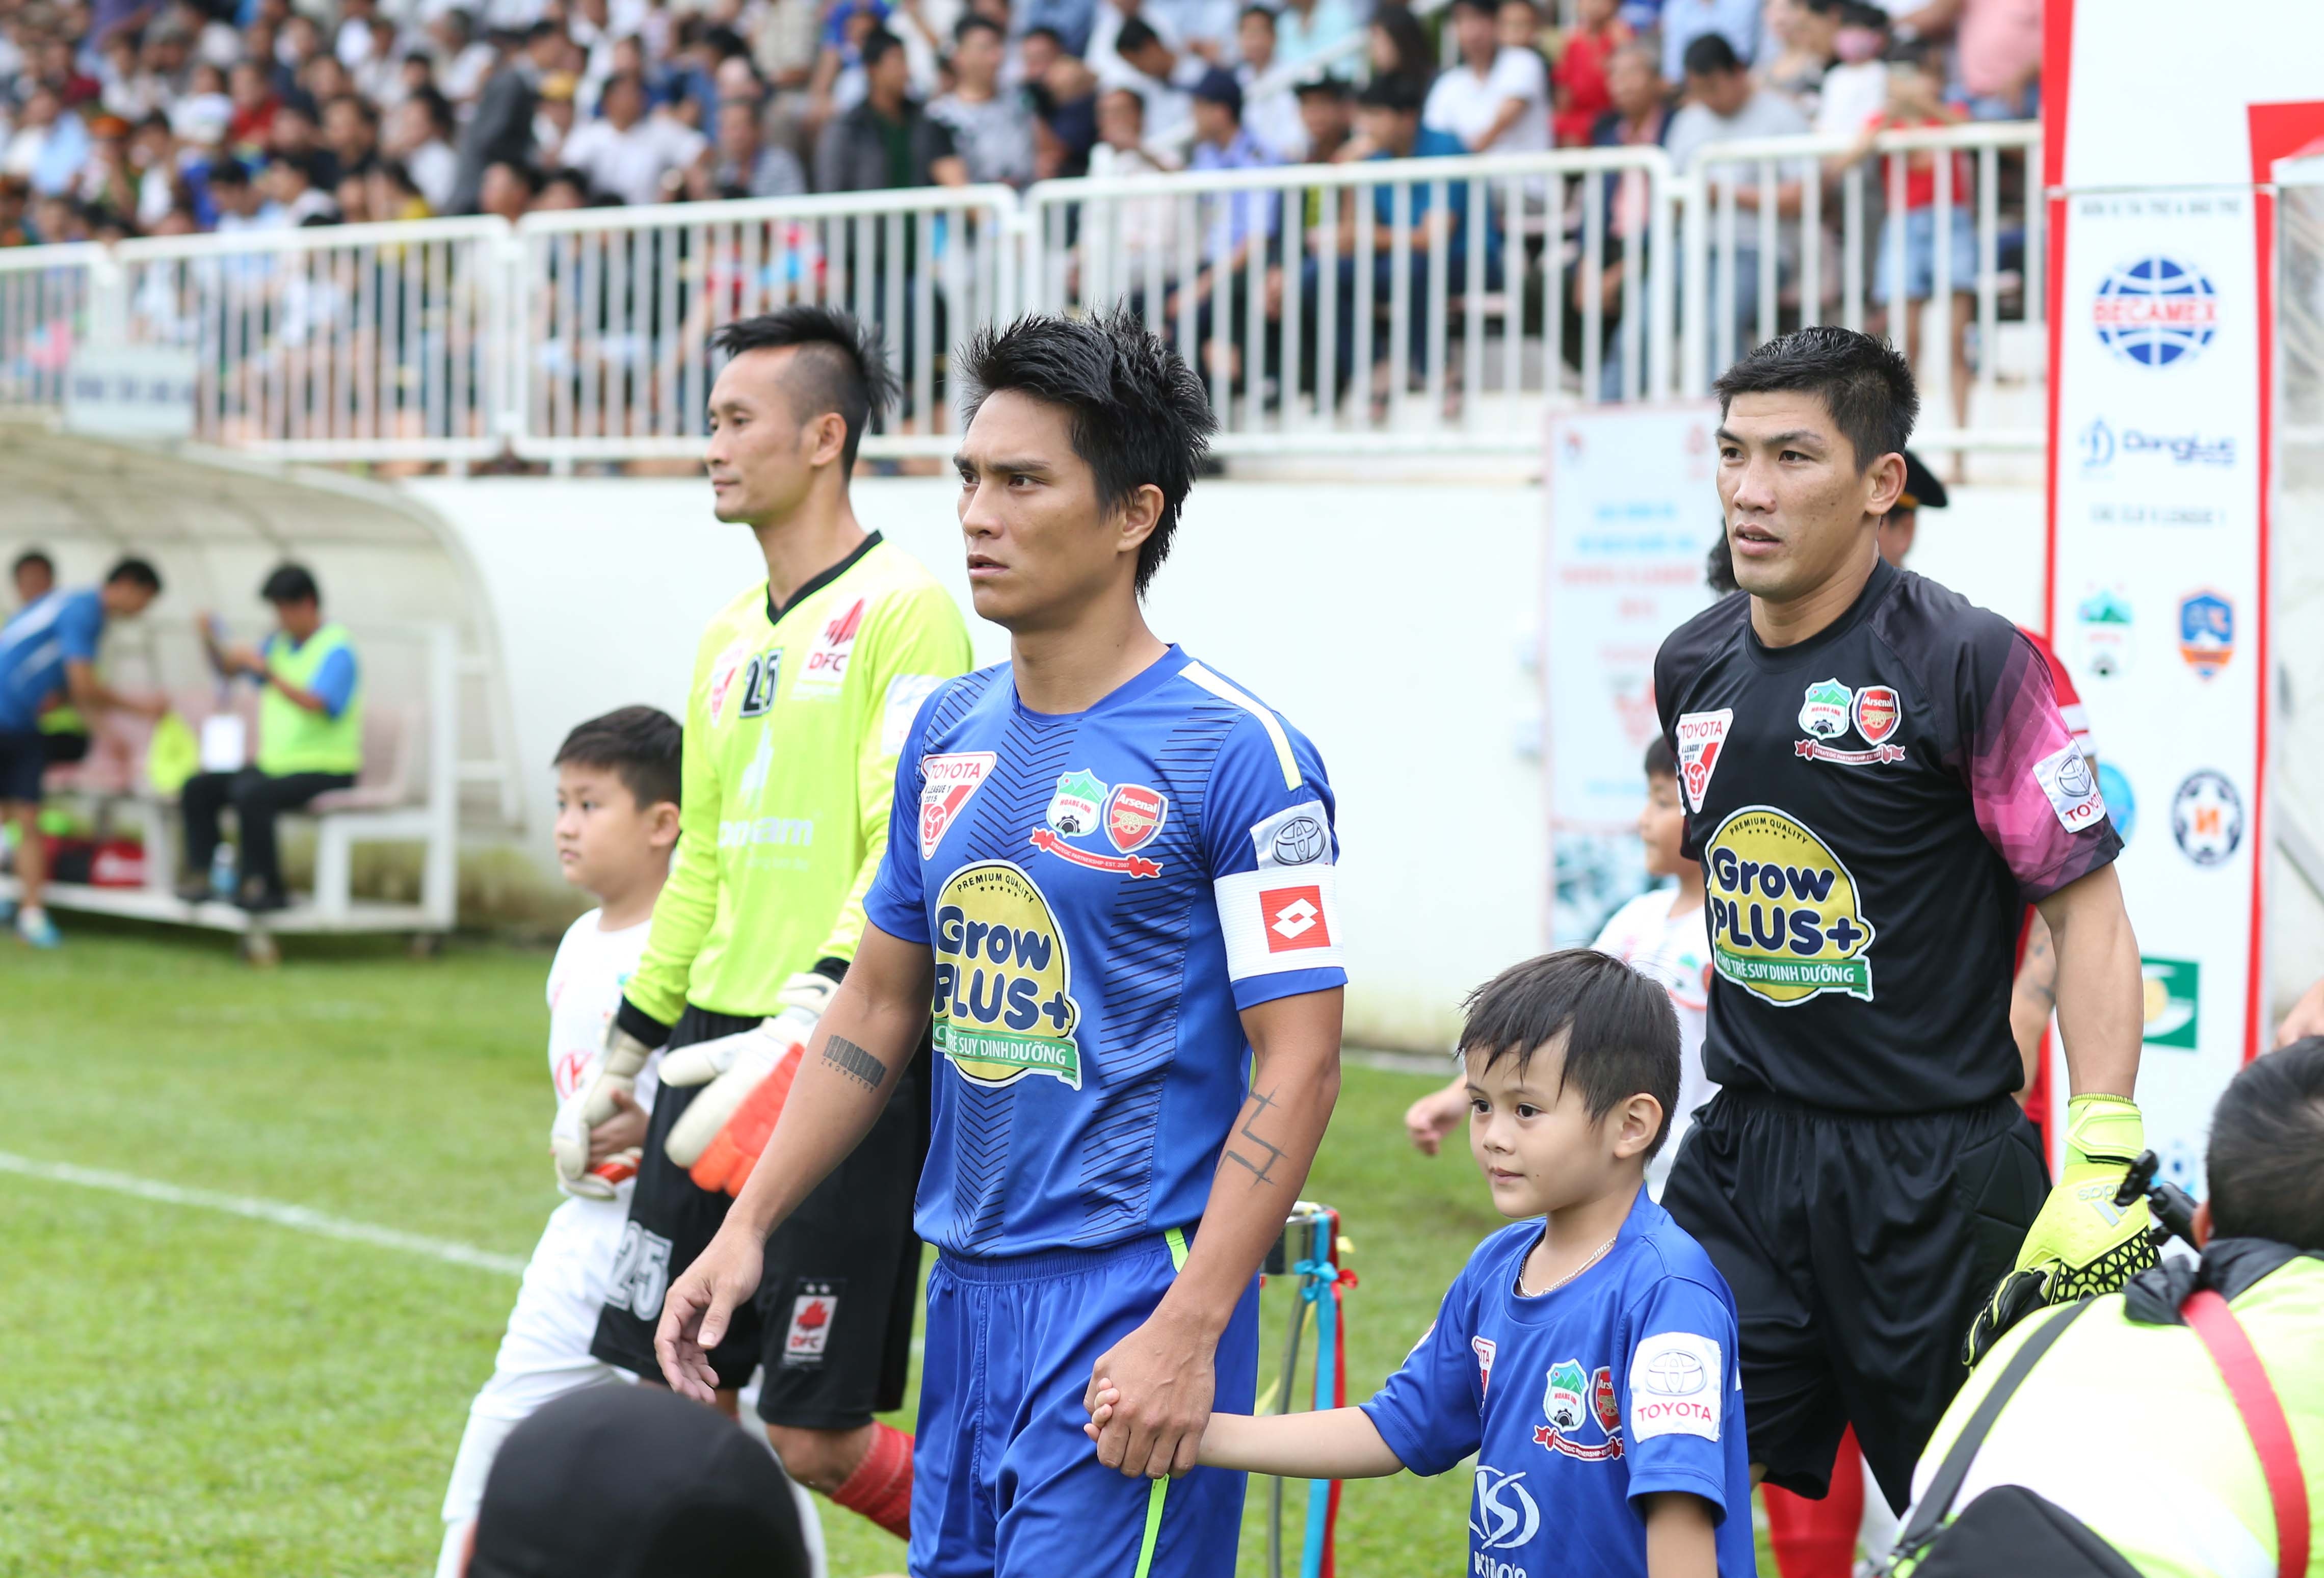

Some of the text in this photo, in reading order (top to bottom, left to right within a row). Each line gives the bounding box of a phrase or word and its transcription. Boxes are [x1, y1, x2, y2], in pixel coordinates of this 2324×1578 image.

[809, 652, 847, 672] DFC
[740, 648, 783, 718] 25
[1863, 697, 1893, 707] Arsenal
[1681, 721, 1722, 739] TOYOTA
[930, 763, 981, 779] TOYOTA
[1060, 799, 1091, 814] HOANG ANH
[1117, 794, 1157, 813] Arsenal
[1730, 818, 1807, 844] PREMIUM QUALITY
[1050, 841, 1071, 856] STRATEGIC
[1712, 848, 1834, 902] Grow
[957, 873, 1034, 904] PREMIUM QUALITY
[938, 906, 1051, 971] Grow
[1712, 897, 1862, 955] PLUS+
[1730, 958, 1748, 977] TRẺ
[1748, 963, 1767, 979] SUY
[1770, 965, 1799, 981] DINH
[1801, 963, 1854, 983] DƯỠNG
[934, 963, 1069, 1031] PLUS+
[959, 1037, 978, 1055] SUY
[980, 1039, 1009, 1059] DINH
[1010, 1040, 1066, 1065] DƯỠNG
[605, 1221, 673, 1320] 25
[1638, 1402, 1711, 1422] TOYOTA
